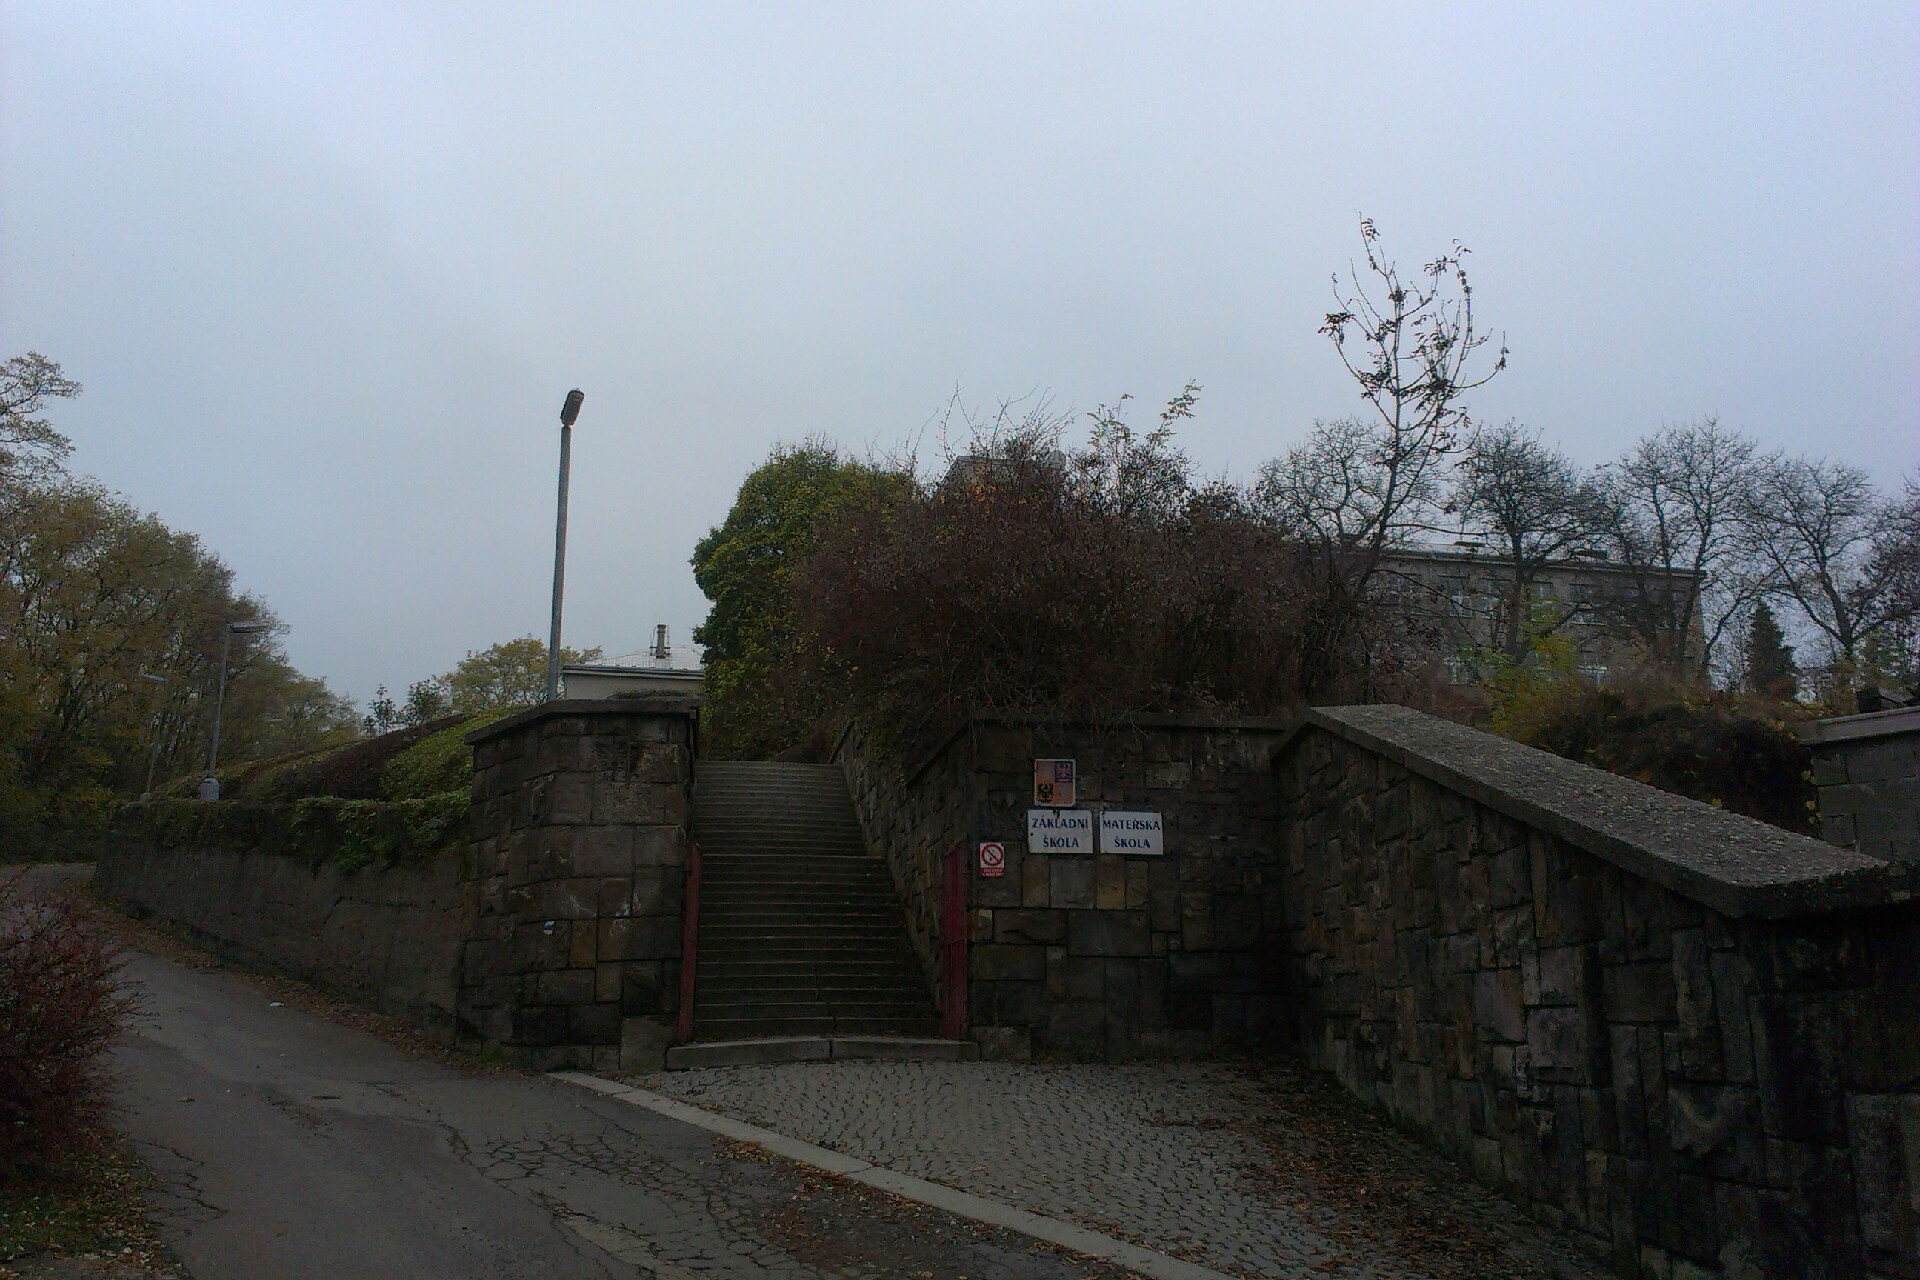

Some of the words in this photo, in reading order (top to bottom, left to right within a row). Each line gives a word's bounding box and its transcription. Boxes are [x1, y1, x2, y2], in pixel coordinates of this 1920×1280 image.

[1032, 815, 1088, 829] ZÁKLADNÍ
[1103, 817, 1160, 830] MATEŘSKÁ
[1043, 835, 1079, 848] ŠKOLA
[1114, 836, 1150, 848] ŠKOLA
